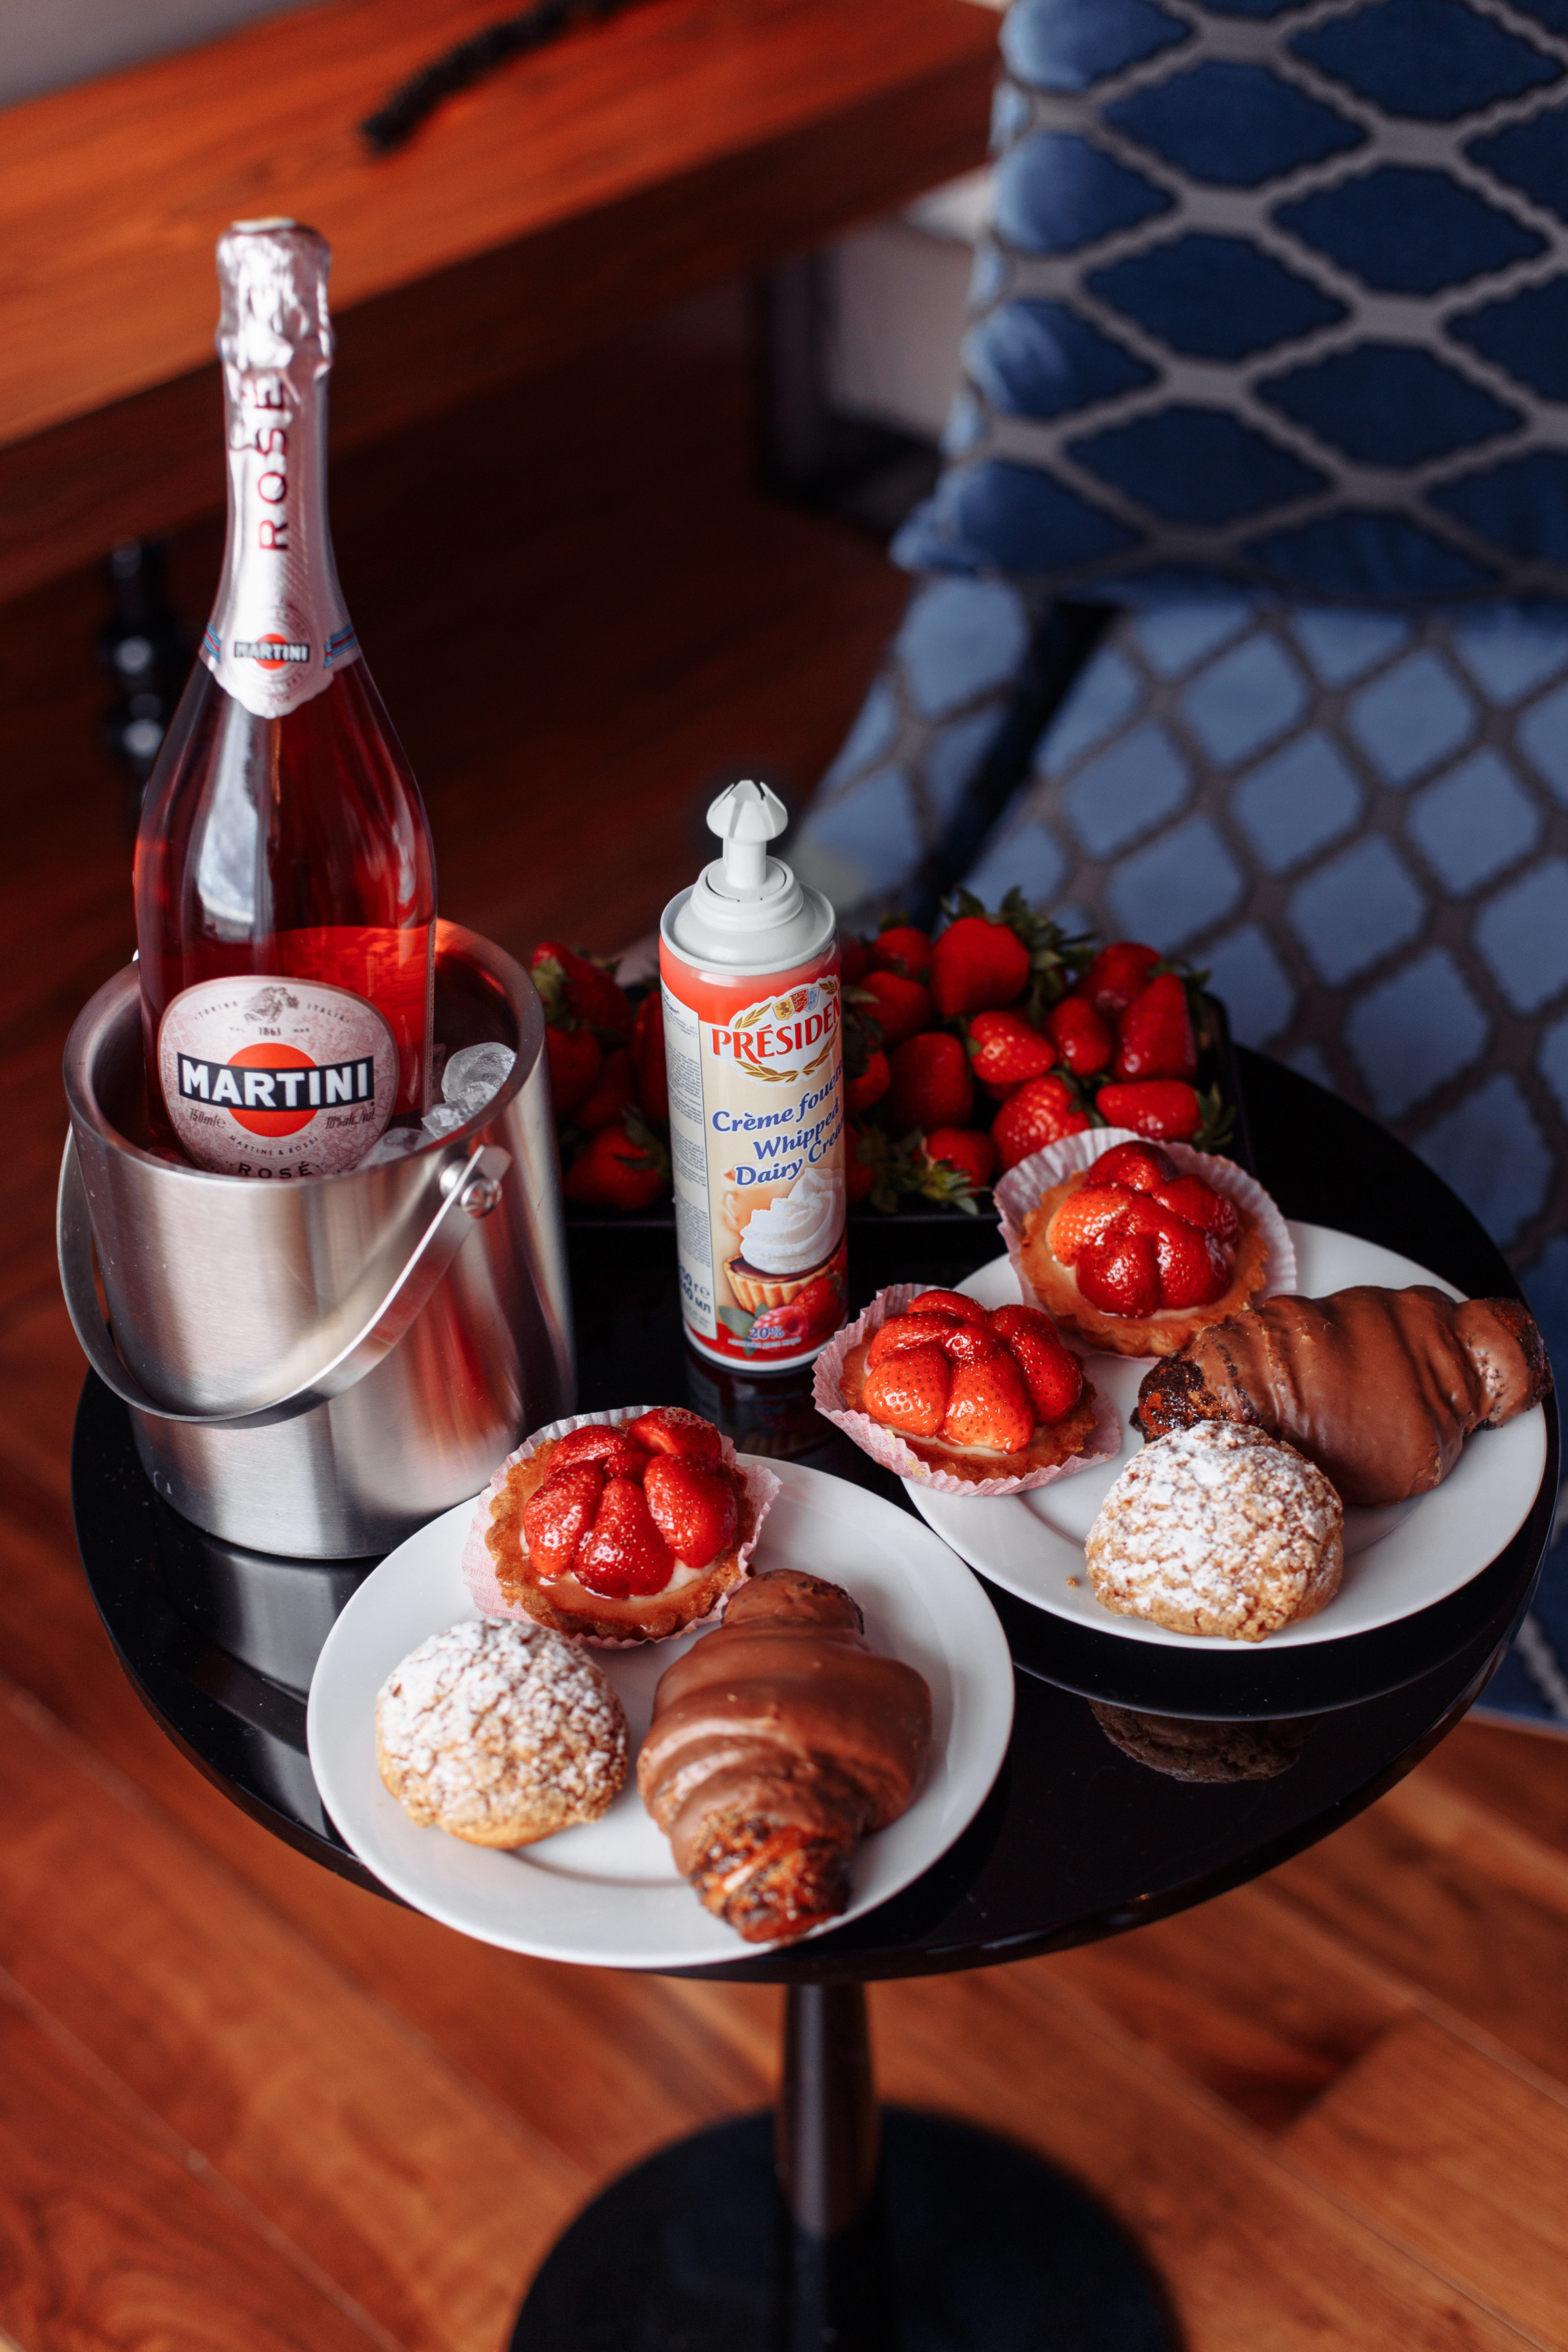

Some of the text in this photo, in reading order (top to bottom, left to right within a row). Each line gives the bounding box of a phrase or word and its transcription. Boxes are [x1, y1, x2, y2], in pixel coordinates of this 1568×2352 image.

[235, 643, 308, 661] MARTINI
[259, 1027, 282, 1036] 1863
[712, 995, 841, 1065] PRÉSIDEN
[182, 1059, 368, 1107] MARTINI
[712, 1108, 794, 1132] Crème
[796, 1059, 843, 1123] fouett
[753, 1096, 839, 1160] Whipped
[229, 1135, 273, 1156] MARTINI
[288, 1137, 319, 1154] ROSSI
[736, 1158, 803, 1186] Dairy
[808, 1112, 844, 1163] Crea
[237, 1160, 312, 1179] ROSÉ
[748, 1326, 784, 1339] 20%
